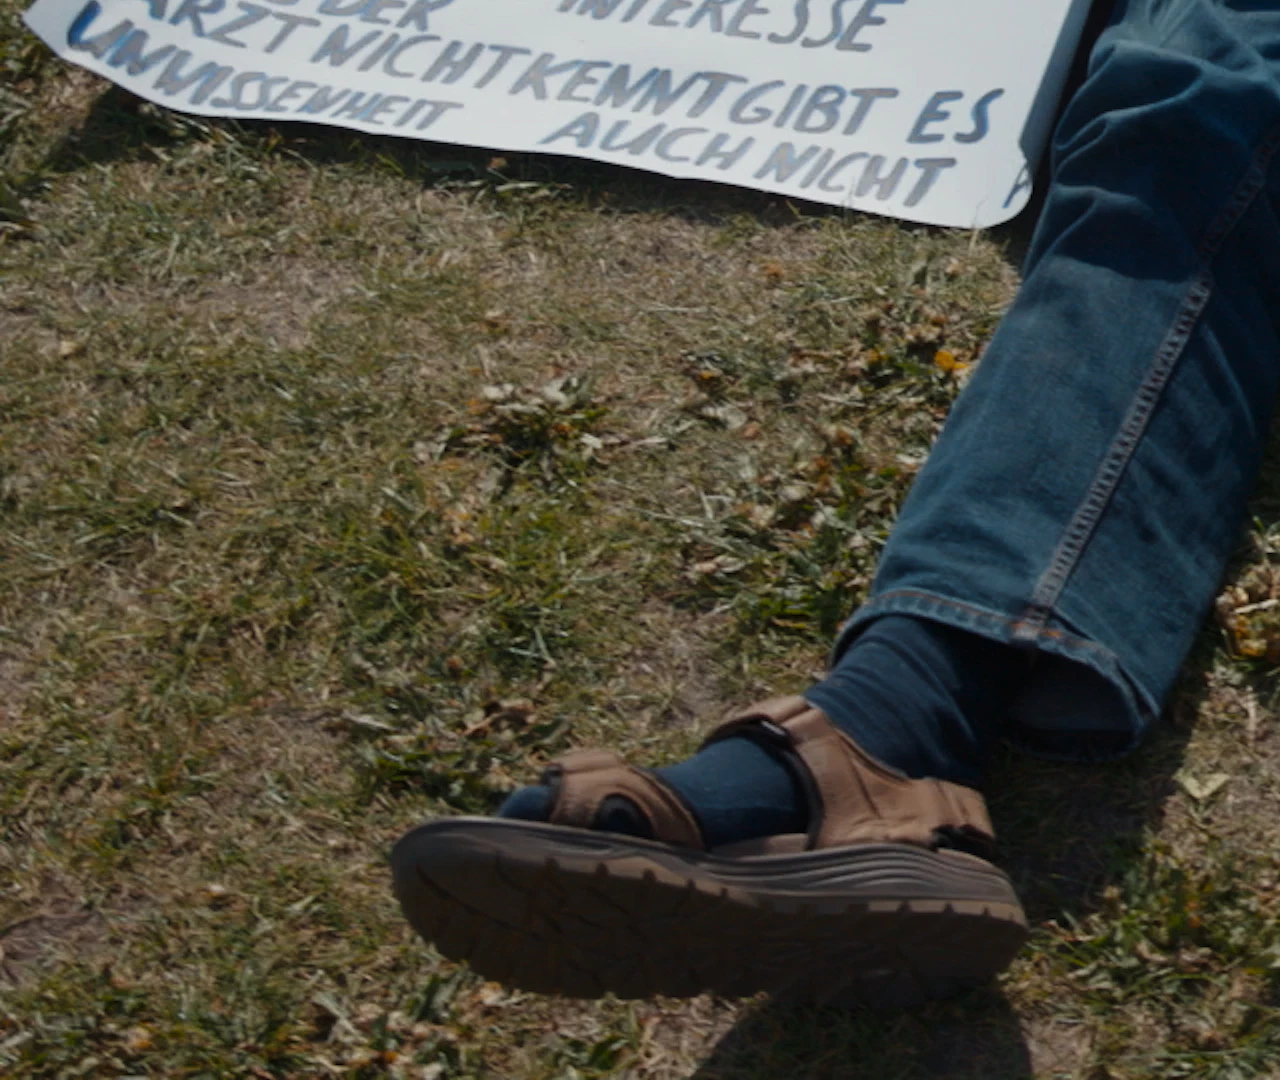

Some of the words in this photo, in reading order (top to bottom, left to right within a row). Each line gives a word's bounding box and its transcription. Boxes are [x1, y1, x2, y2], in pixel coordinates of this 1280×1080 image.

[907, 88, 1004, 145] ES
[538, 112, 753, 170] AUCH
[753, 142, 957, 208] NICHT
